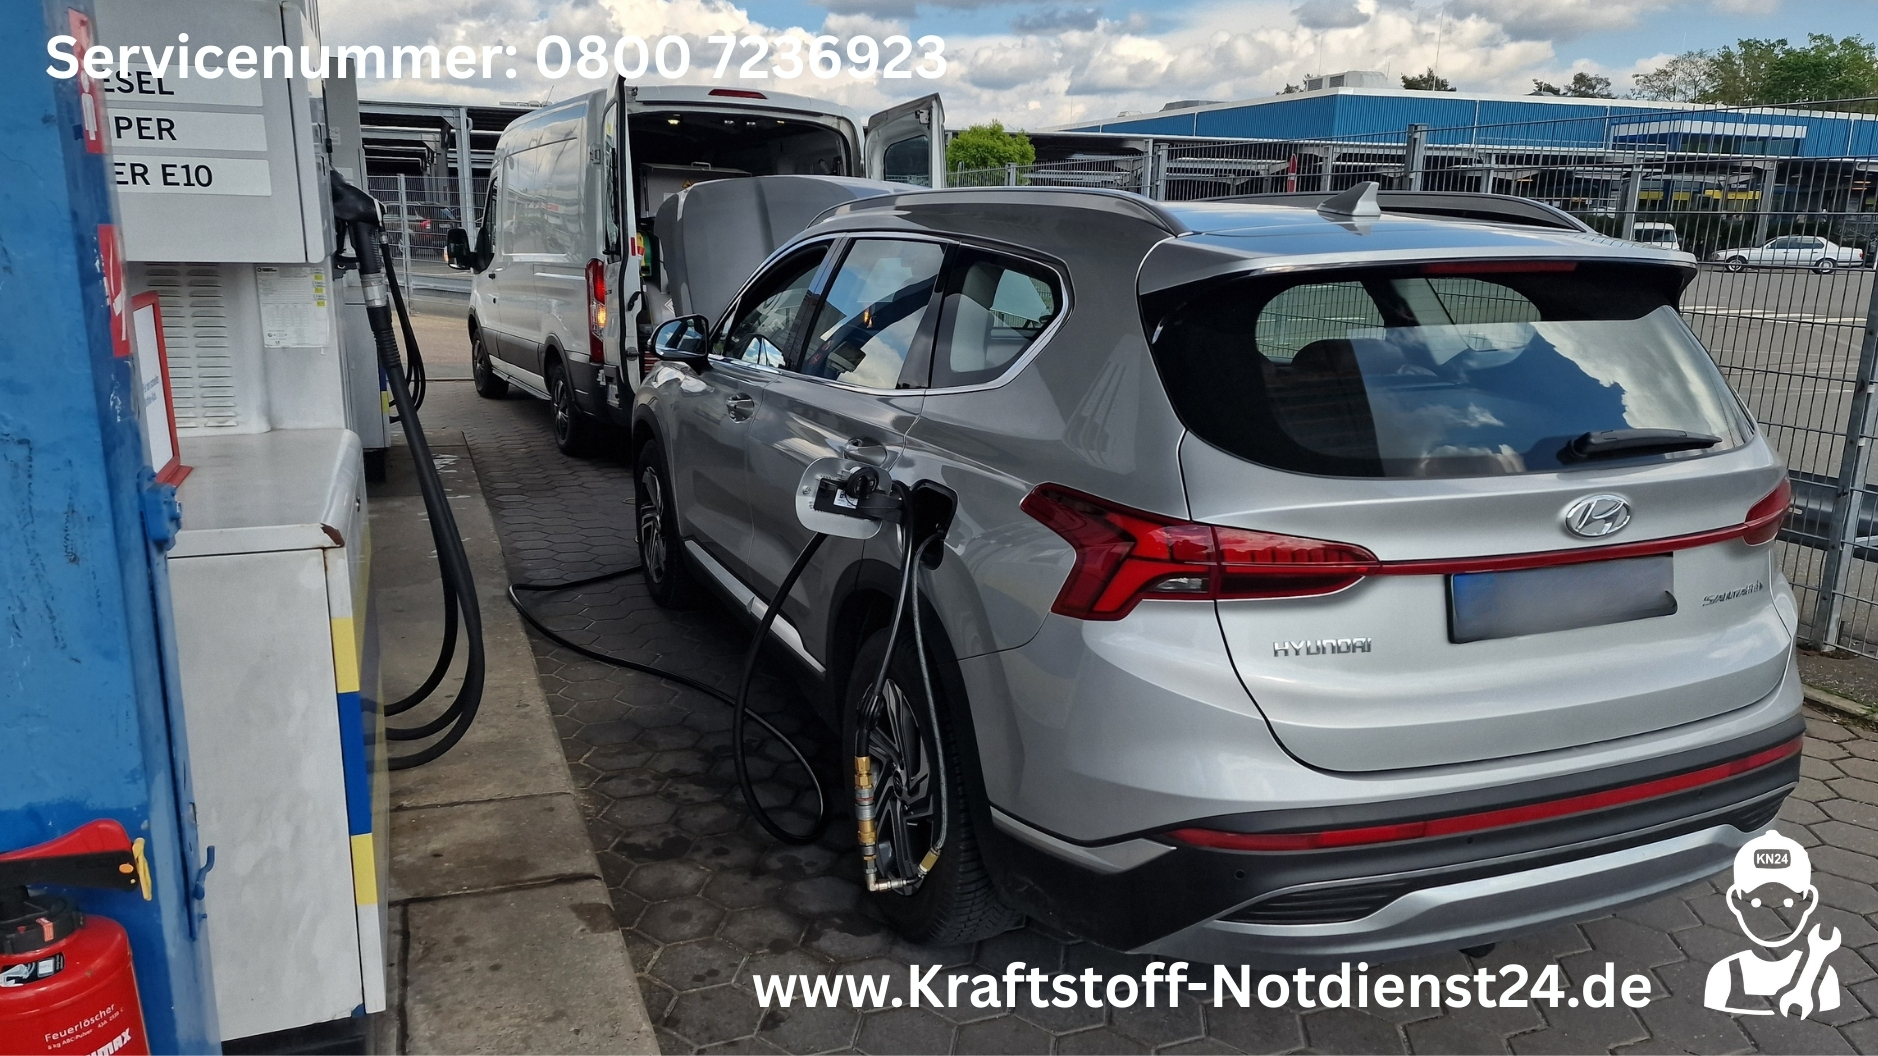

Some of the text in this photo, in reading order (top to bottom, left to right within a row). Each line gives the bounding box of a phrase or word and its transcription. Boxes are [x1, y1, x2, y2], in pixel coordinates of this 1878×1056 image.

[161, 163, 213, 188] E10
[1273, 637, 1372, 657] HYUNDAI
[44, 1004, 115, 1042] Feuerlöscher
